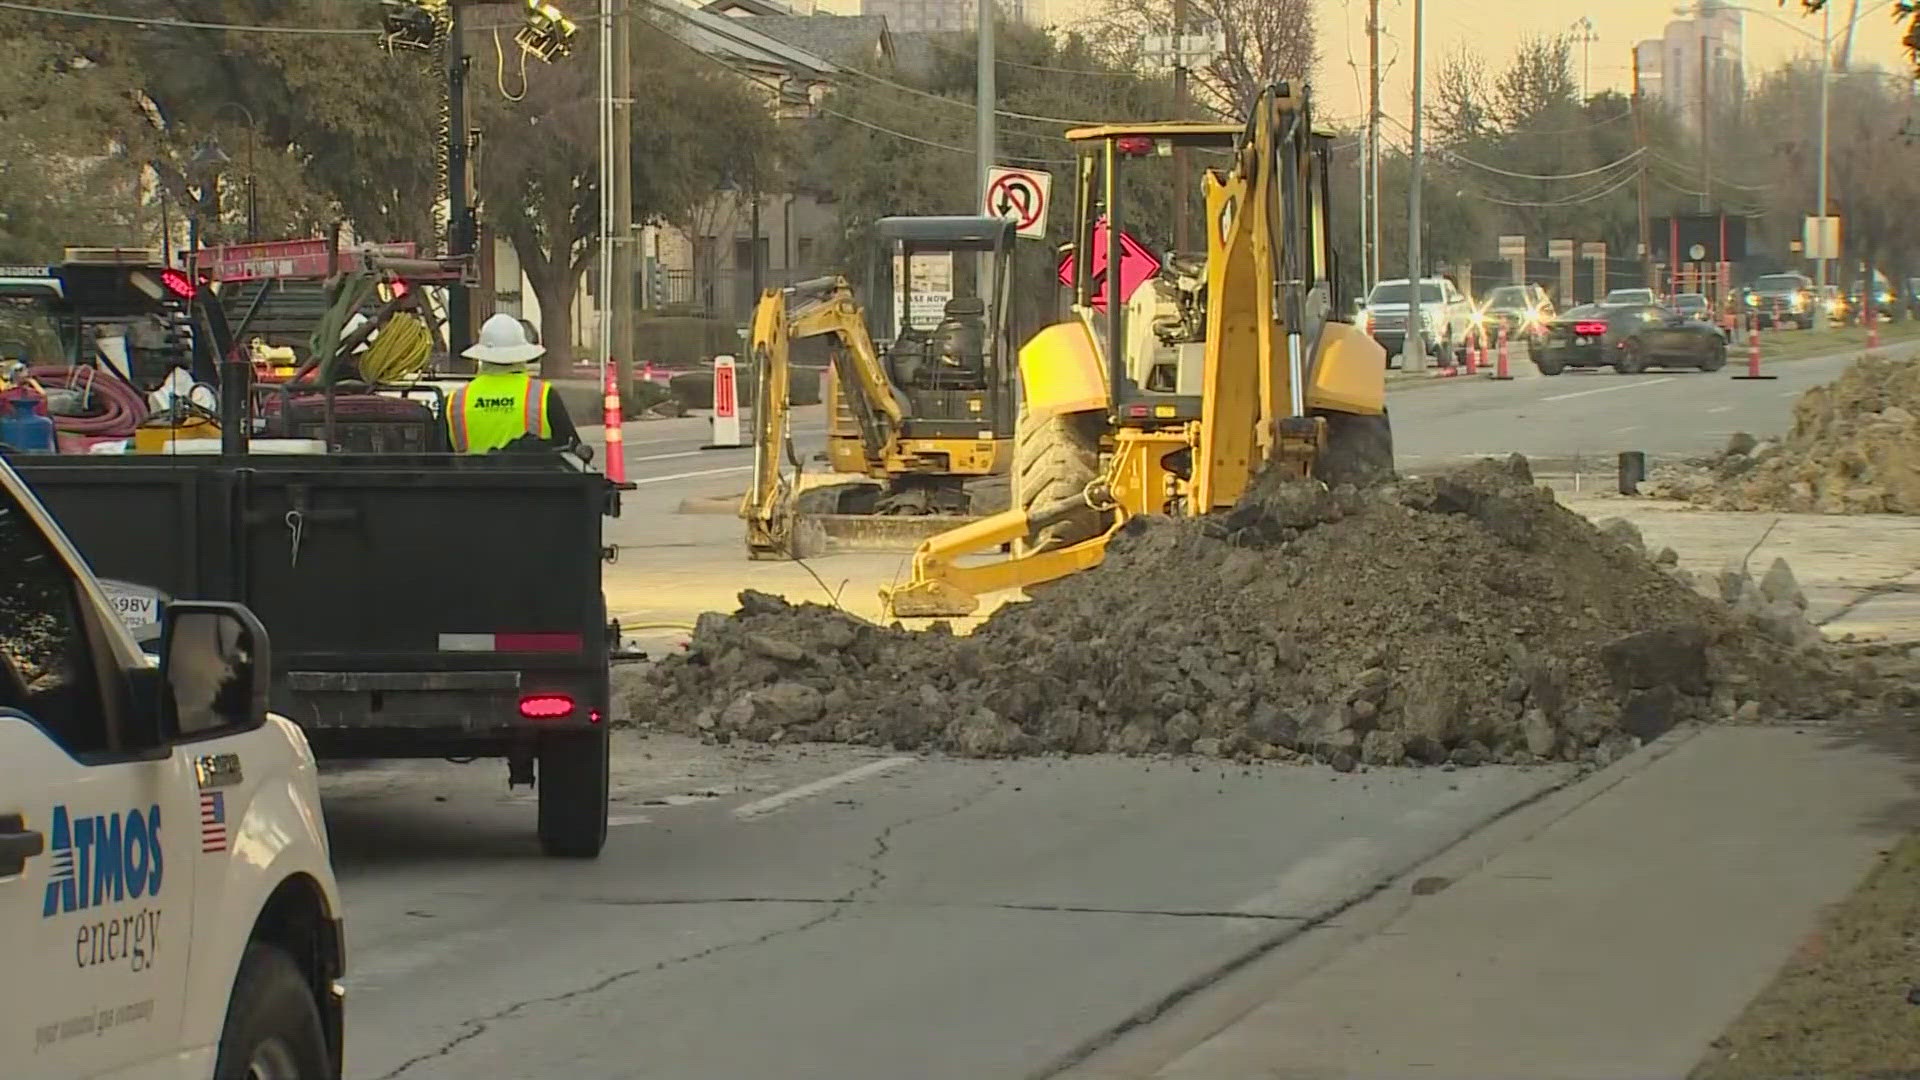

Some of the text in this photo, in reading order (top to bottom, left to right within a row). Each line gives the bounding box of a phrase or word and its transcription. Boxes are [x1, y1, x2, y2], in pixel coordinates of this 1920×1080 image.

[897, 295, 924, 303] LSE
[474, 397, 514, 407] ATMOS
[43, 803, 163, 917] ATMOS
[76, 908, 162, 972] energy
